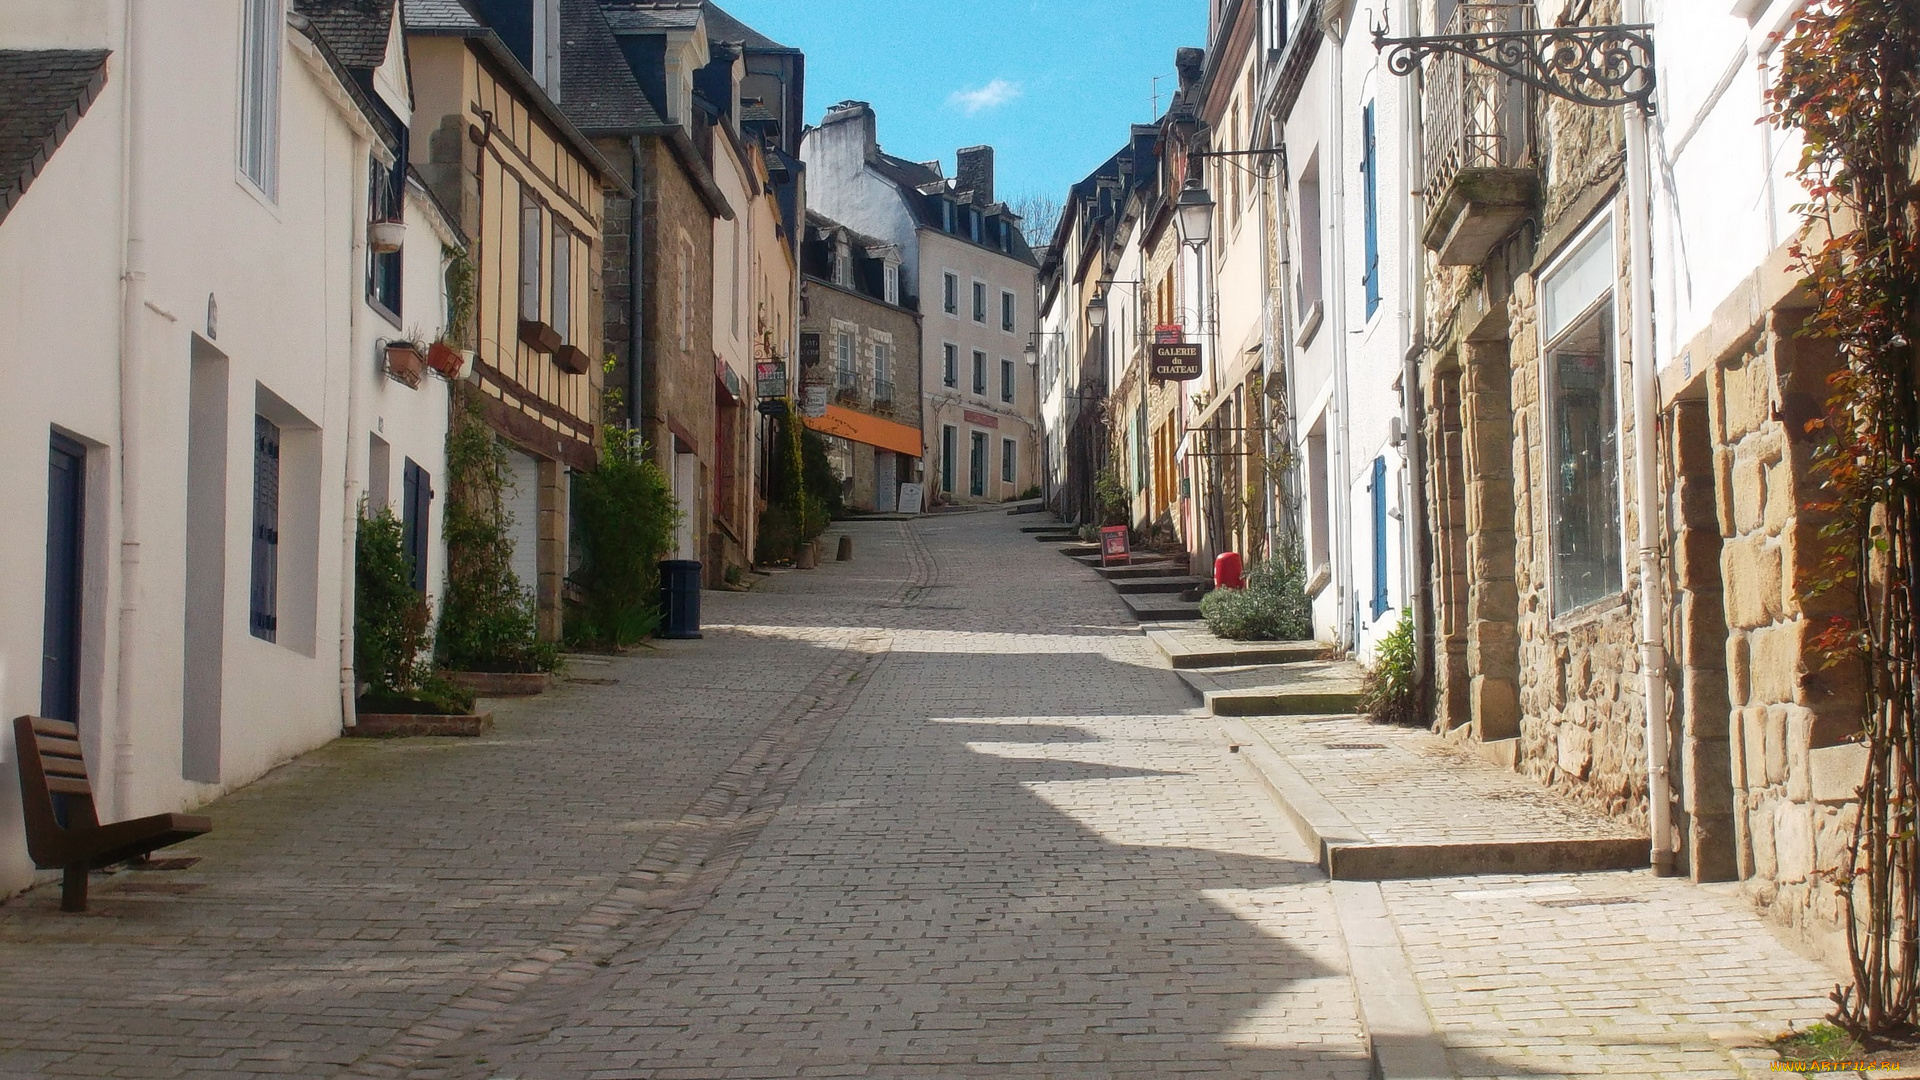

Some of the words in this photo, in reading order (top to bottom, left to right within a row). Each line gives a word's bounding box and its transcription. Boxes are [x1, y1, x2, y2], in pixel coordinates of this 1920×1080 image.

[1158, 347, 1196, 356] GALERIE
[1172, 357, 1182, 365] du
[1157, 365, 1198, 374] CHATEAU
